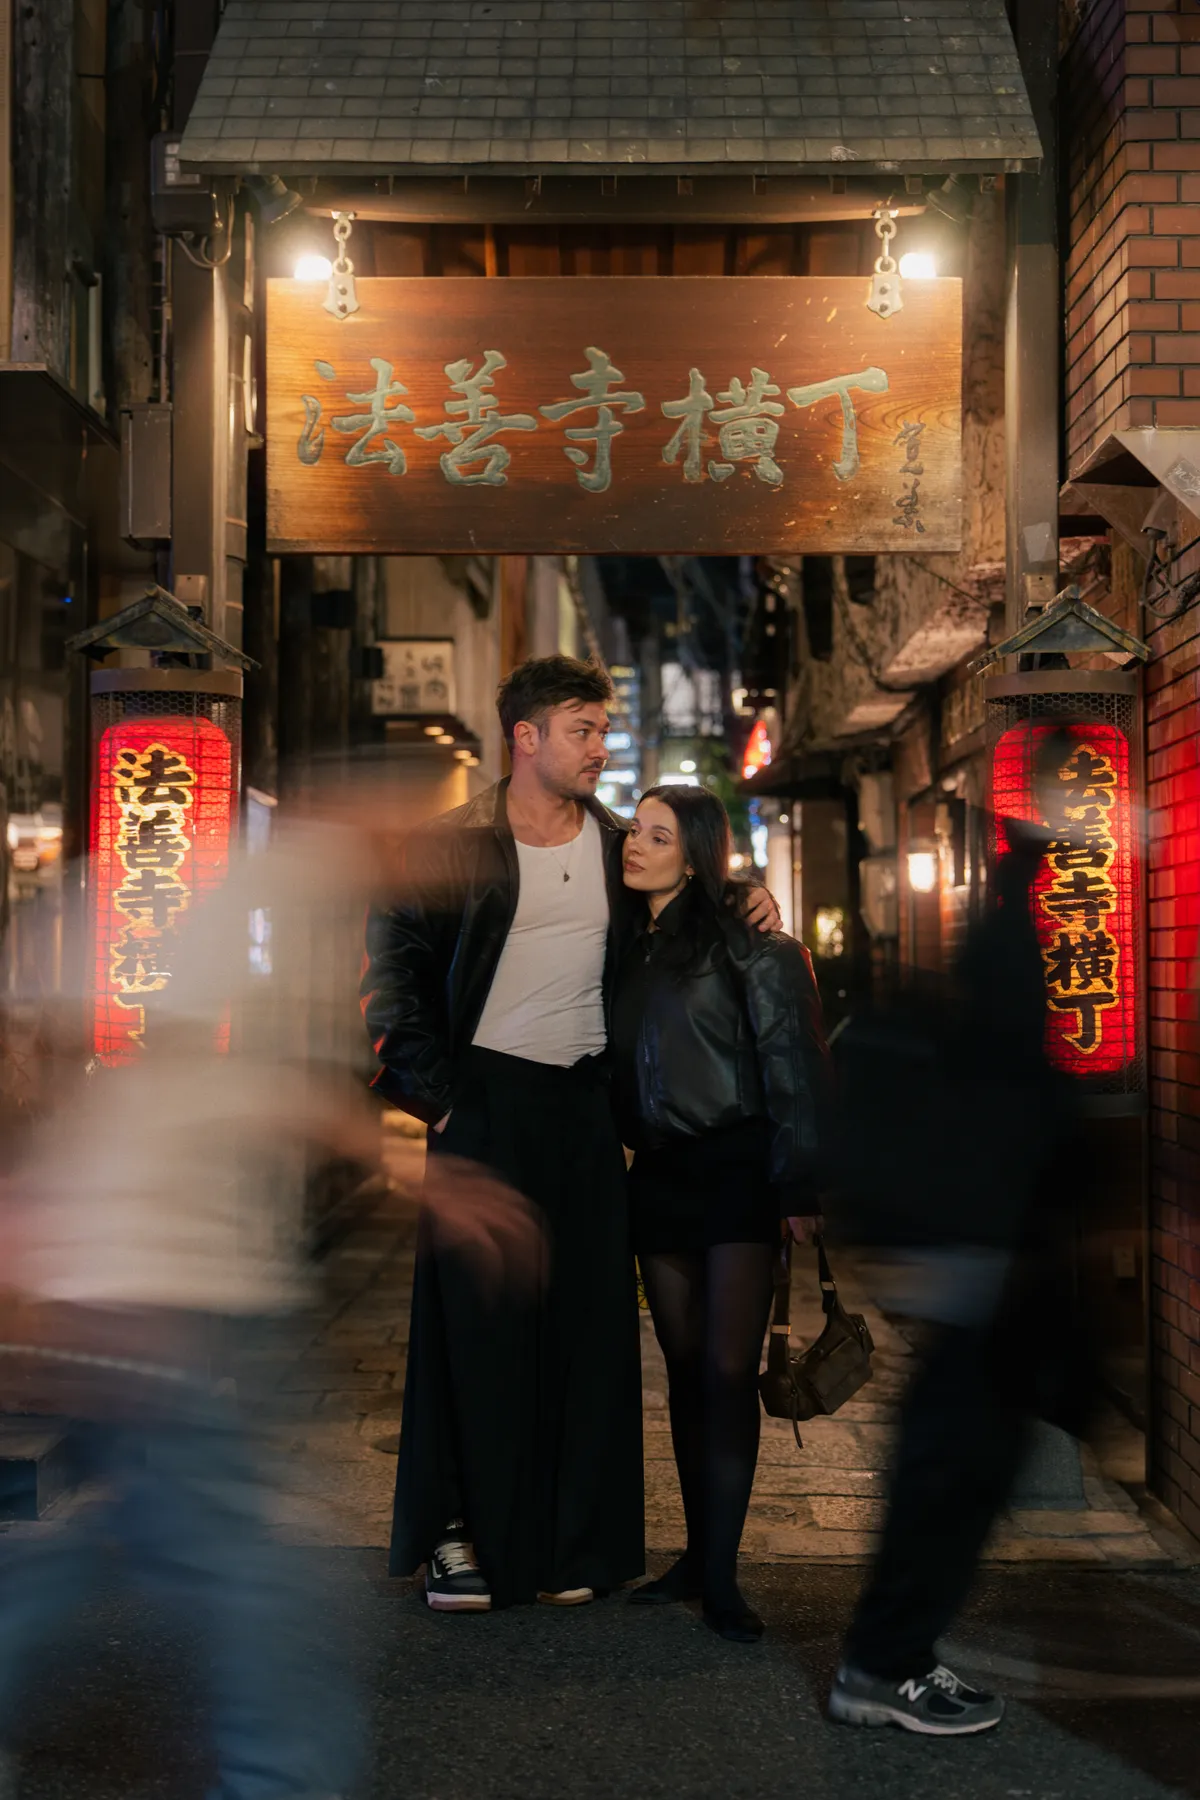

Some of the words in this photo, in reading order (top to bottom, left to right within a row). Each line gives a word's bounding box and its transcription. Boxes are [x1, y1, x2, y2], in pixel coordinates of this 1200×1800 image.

[298, 346, 889, 492] 法善寺横丁
